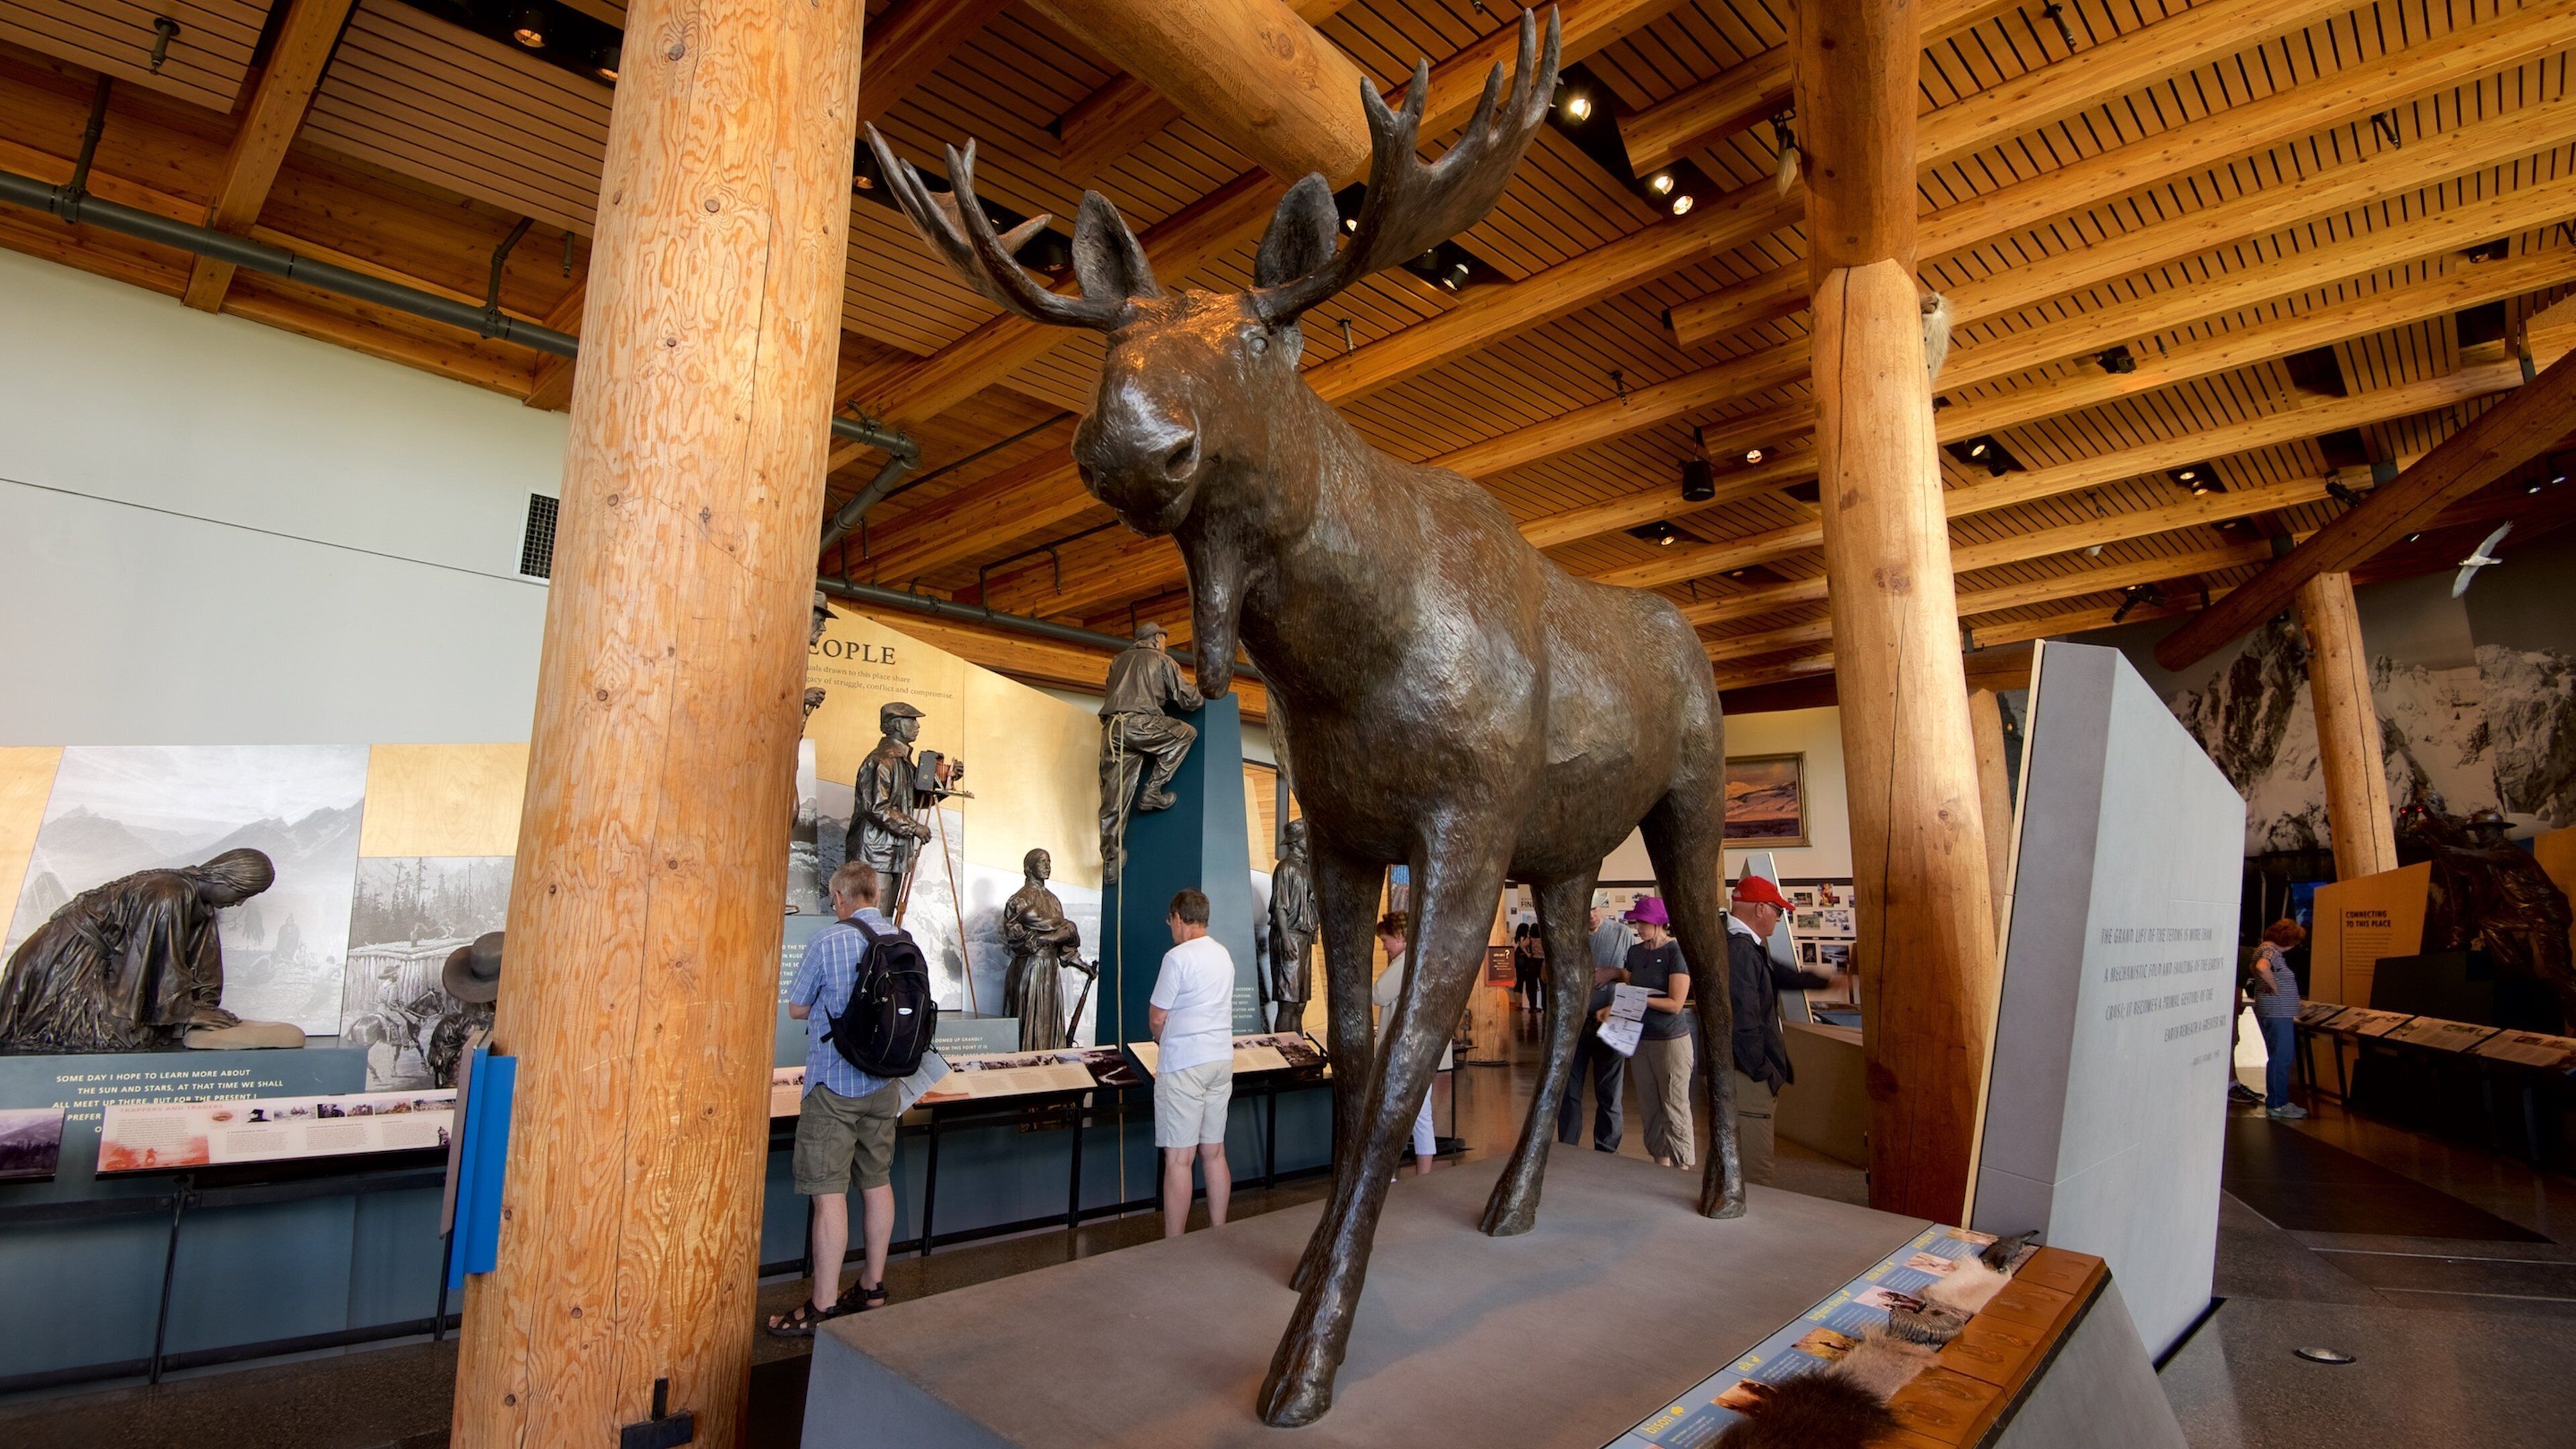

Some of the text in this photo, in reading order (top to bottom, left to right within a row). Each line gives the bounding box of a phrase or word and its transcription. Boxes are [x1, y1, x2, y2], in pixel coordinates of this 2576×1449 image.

[808, 639, 896, 665] OPLE
[823, 666, 847, 675] drawn
[857, 669, 871, 678] this
[872, 672, 891, 682] place
[892, 674, 911, 683] share
[806, 676, 822, 684] gacy
[834, 678, 865, 690] struggle,
[866, 682, 894, 692] conflict
[910, 688, 955, 699] compromise.
[2346, 910, 2387, 918] CONNECTING
[2101, 928, 2112, 945] THE
[2114, 928, 2133, 944] GRAND
[2147, 928, 2155, 943] OF
[2156, 928, 2165, 943] THE
[2104, 968, 2108, 983] A
[56, 1075, 84, 1083] SOME
[144, 1084, 174, 1092] STARS,
[67, 1113, 101, 1121] PREFER
[1737, 1360, 1755, 1371] elk
[1641, 1413, 1675, 1435] bison
